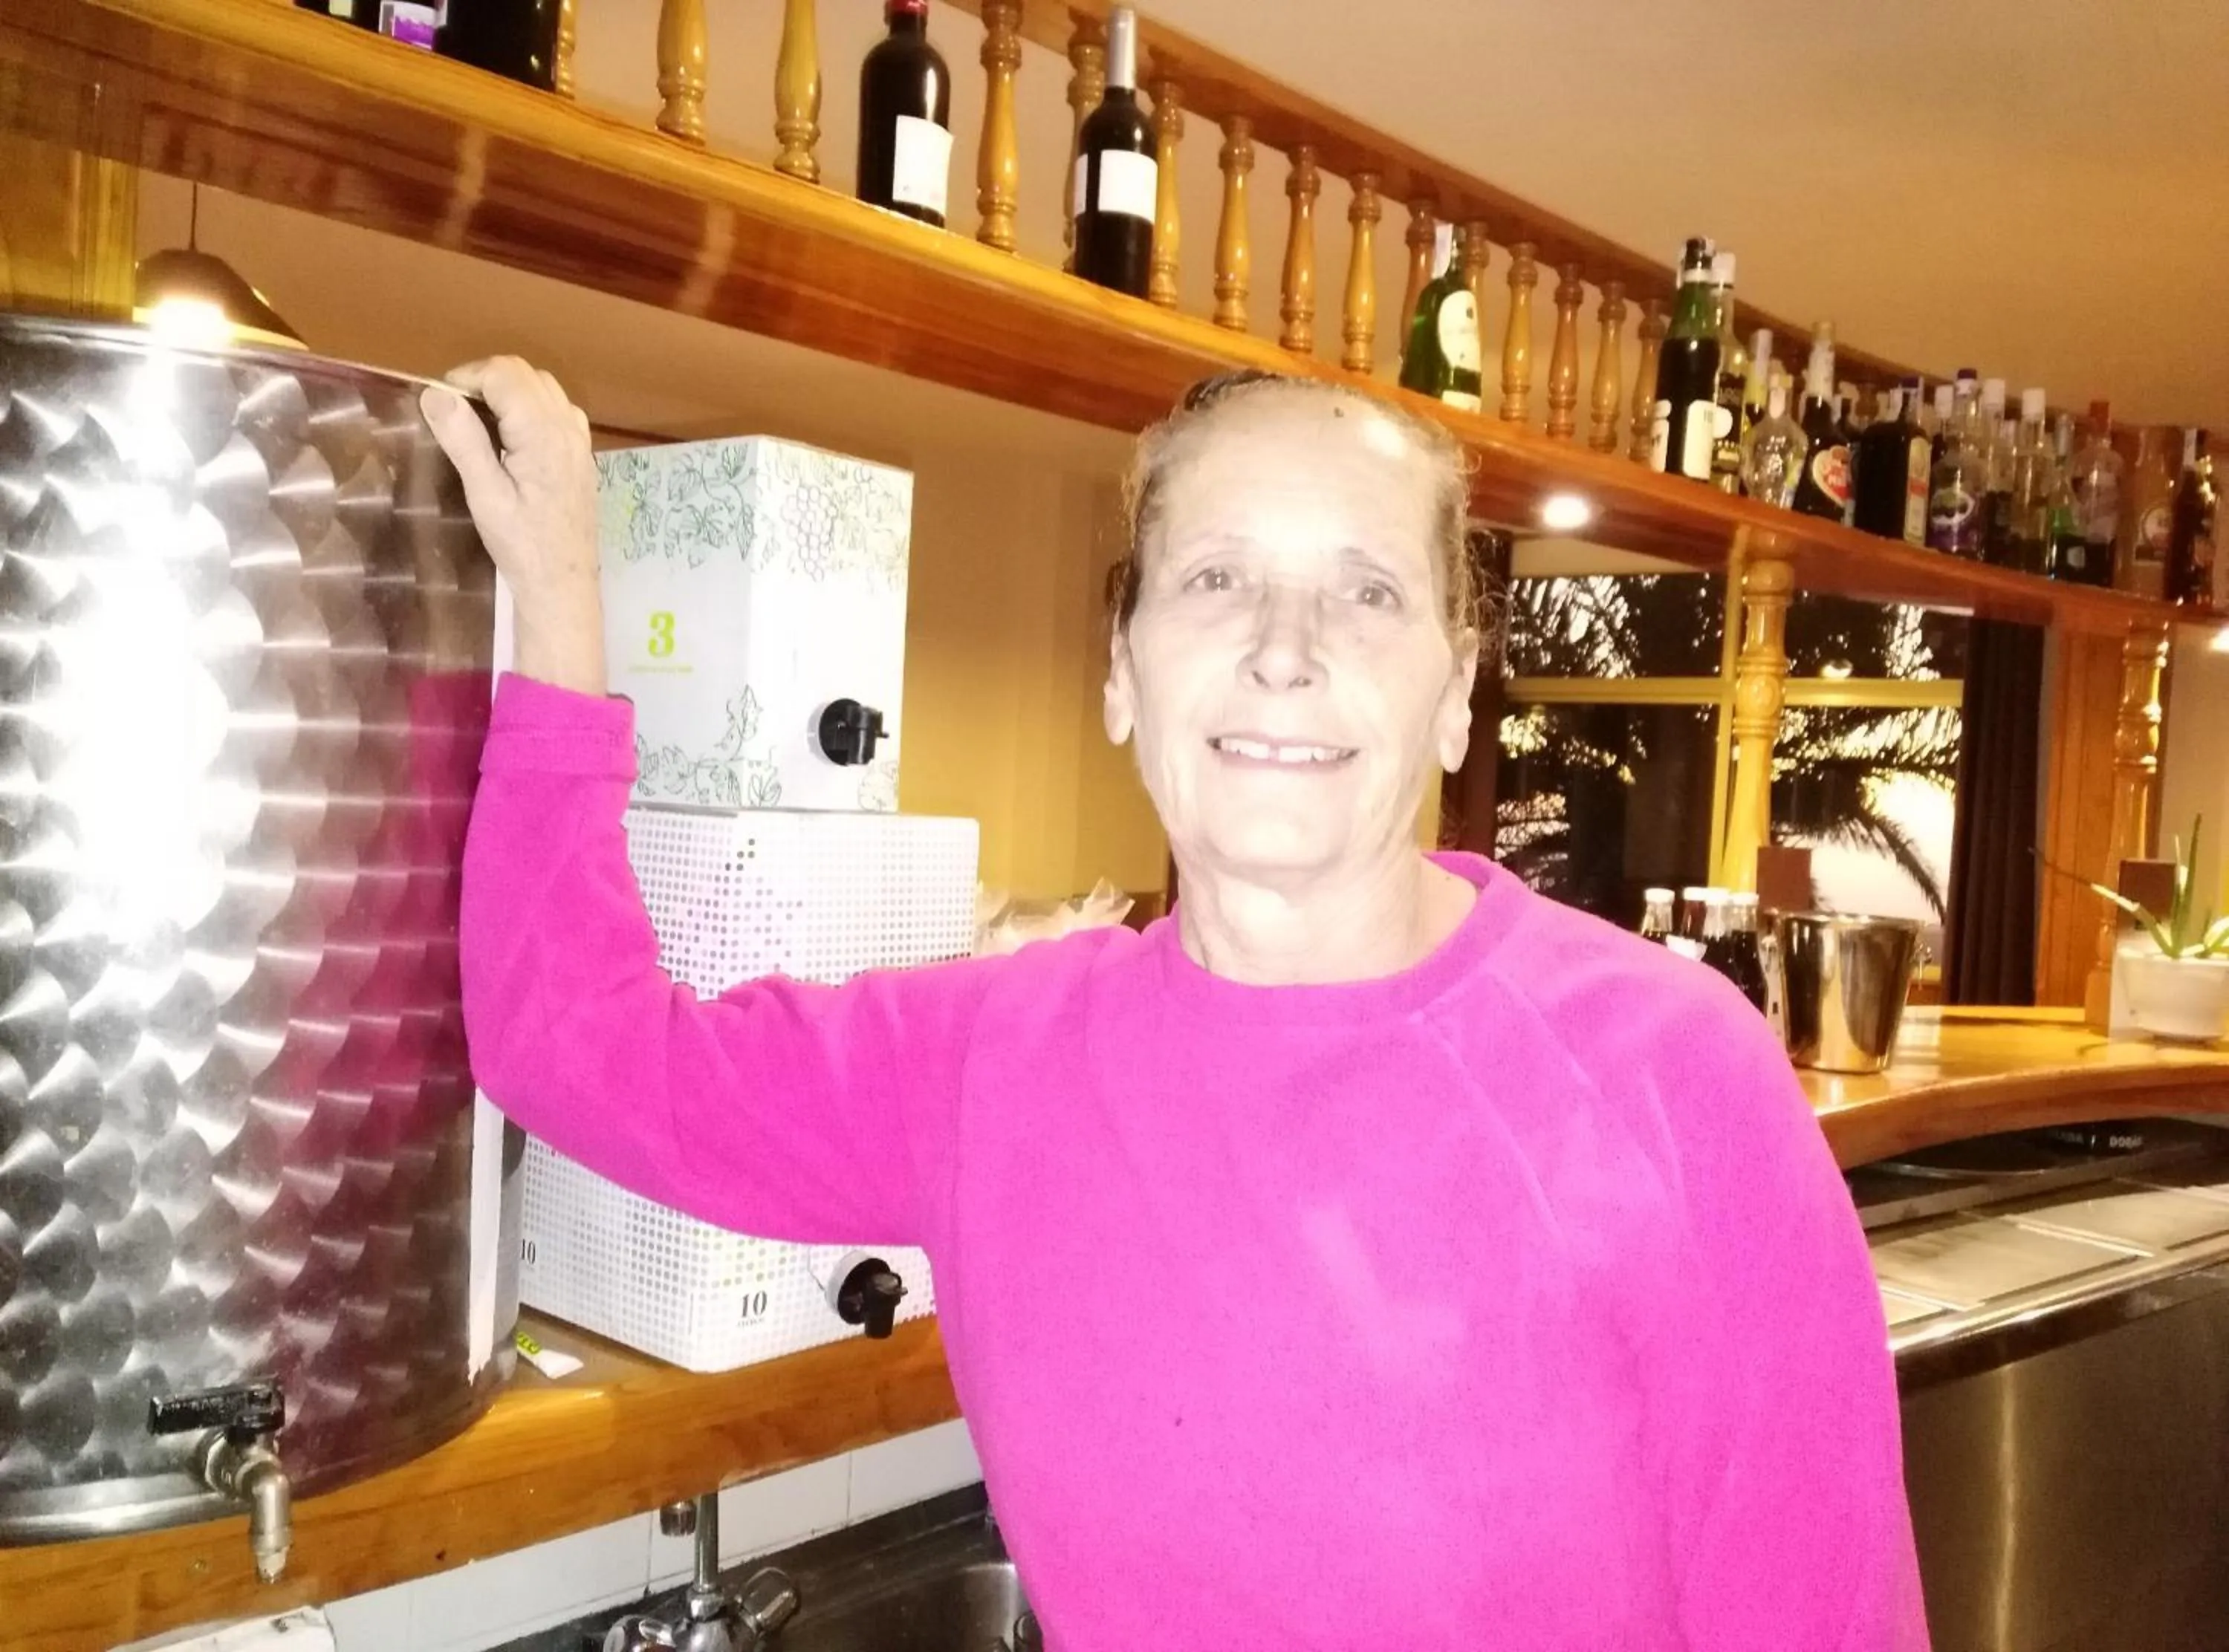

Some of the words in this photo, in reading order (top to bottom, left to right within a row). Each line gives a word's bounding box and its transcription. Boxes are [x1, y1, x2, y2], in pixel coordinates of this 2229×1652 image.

[649, 611, 675, 658] 3
[521, 1238, 536, 1264] 10
[742, 1290, 768, 1318] 10
